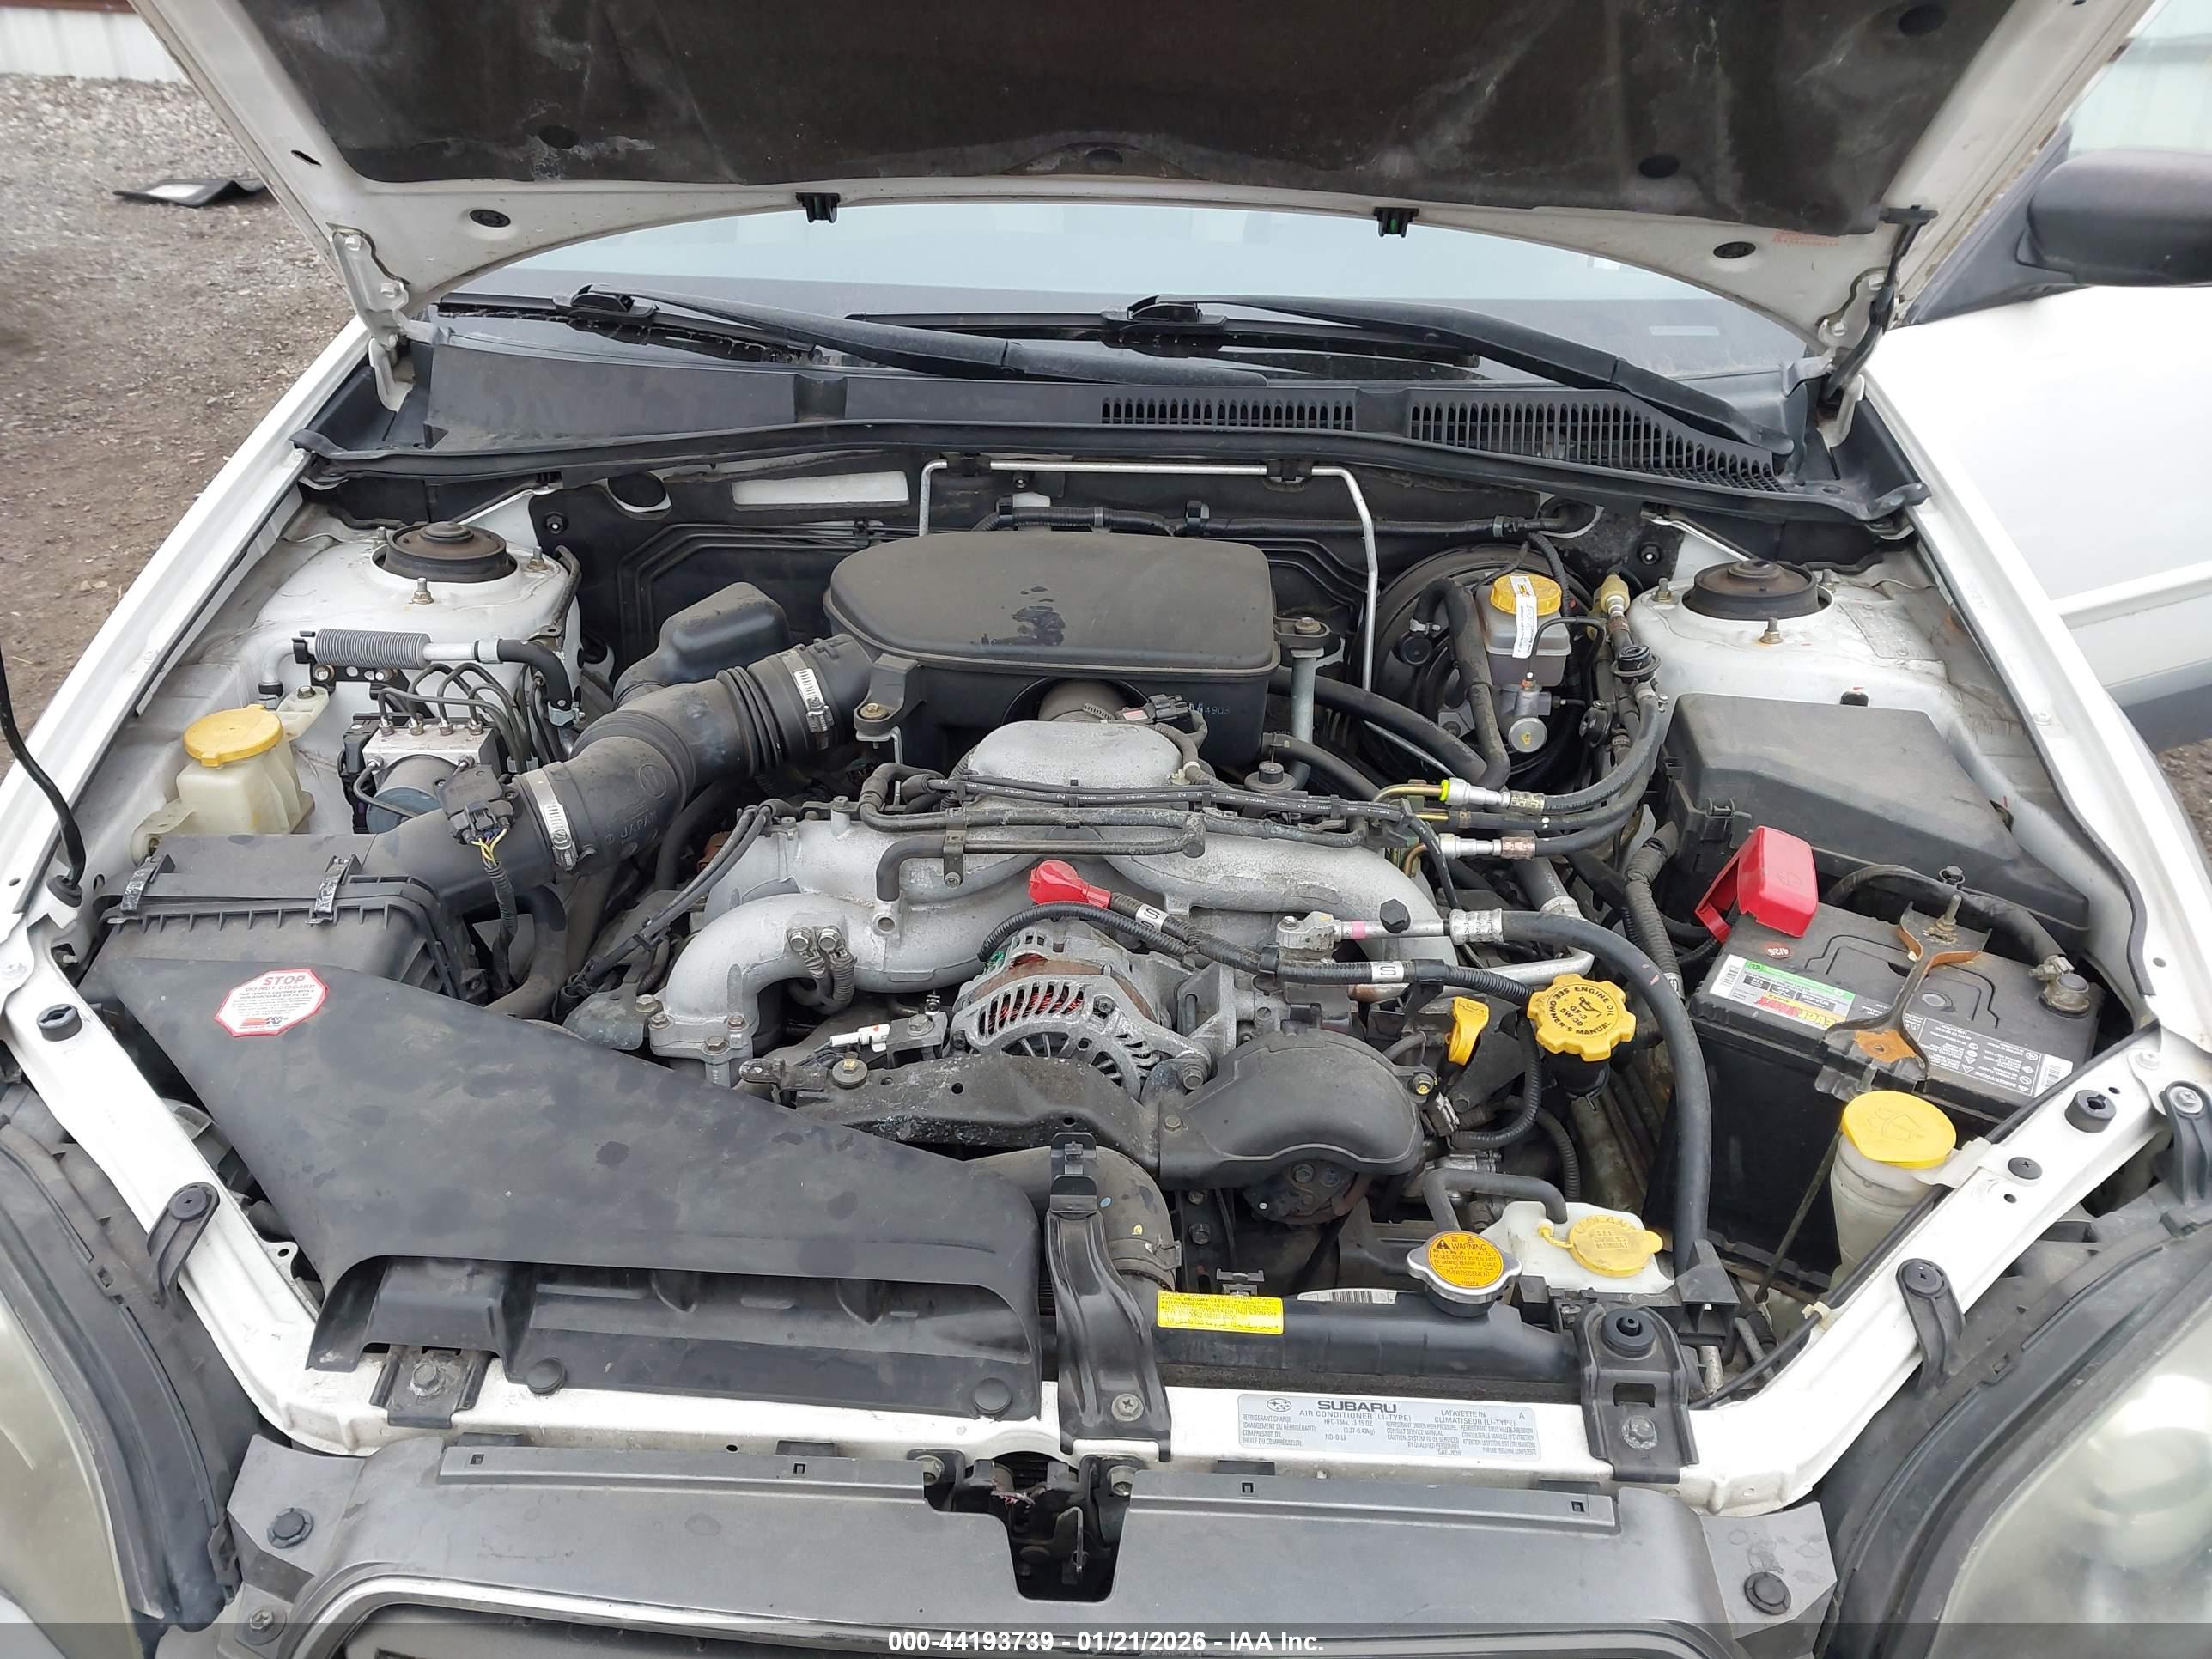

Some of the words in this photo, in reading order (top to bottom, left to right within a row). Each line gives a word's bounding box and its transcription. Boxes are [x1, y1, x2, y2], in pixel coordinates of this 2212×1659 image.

[1767, 947, 1790, 957] 4/25
[263, 975, 306, 986] STOP
[1553, 988, 1570, 1000] SEE
[1575, 986, 1610, 1003] ENGINE
[1550, 1000, 1573, 1031] OWNER'S
[1559, 1008, 1583, 1026] 5W-30
[1576, 1022, 1611, 1035] MANUAL
[1452, 1243, 1486, 1251] WARNING
[1317, 1400, 1397, 1413] SUBARU
[1243, 1413, 1273, 1422] REFRIGERANT
[1316, 1411, 1373, 1420] CONDITIONER
[1441, 1409, 1477, 1418] LAFAYETTE
[1518, 1412, 1526, 1420] A
